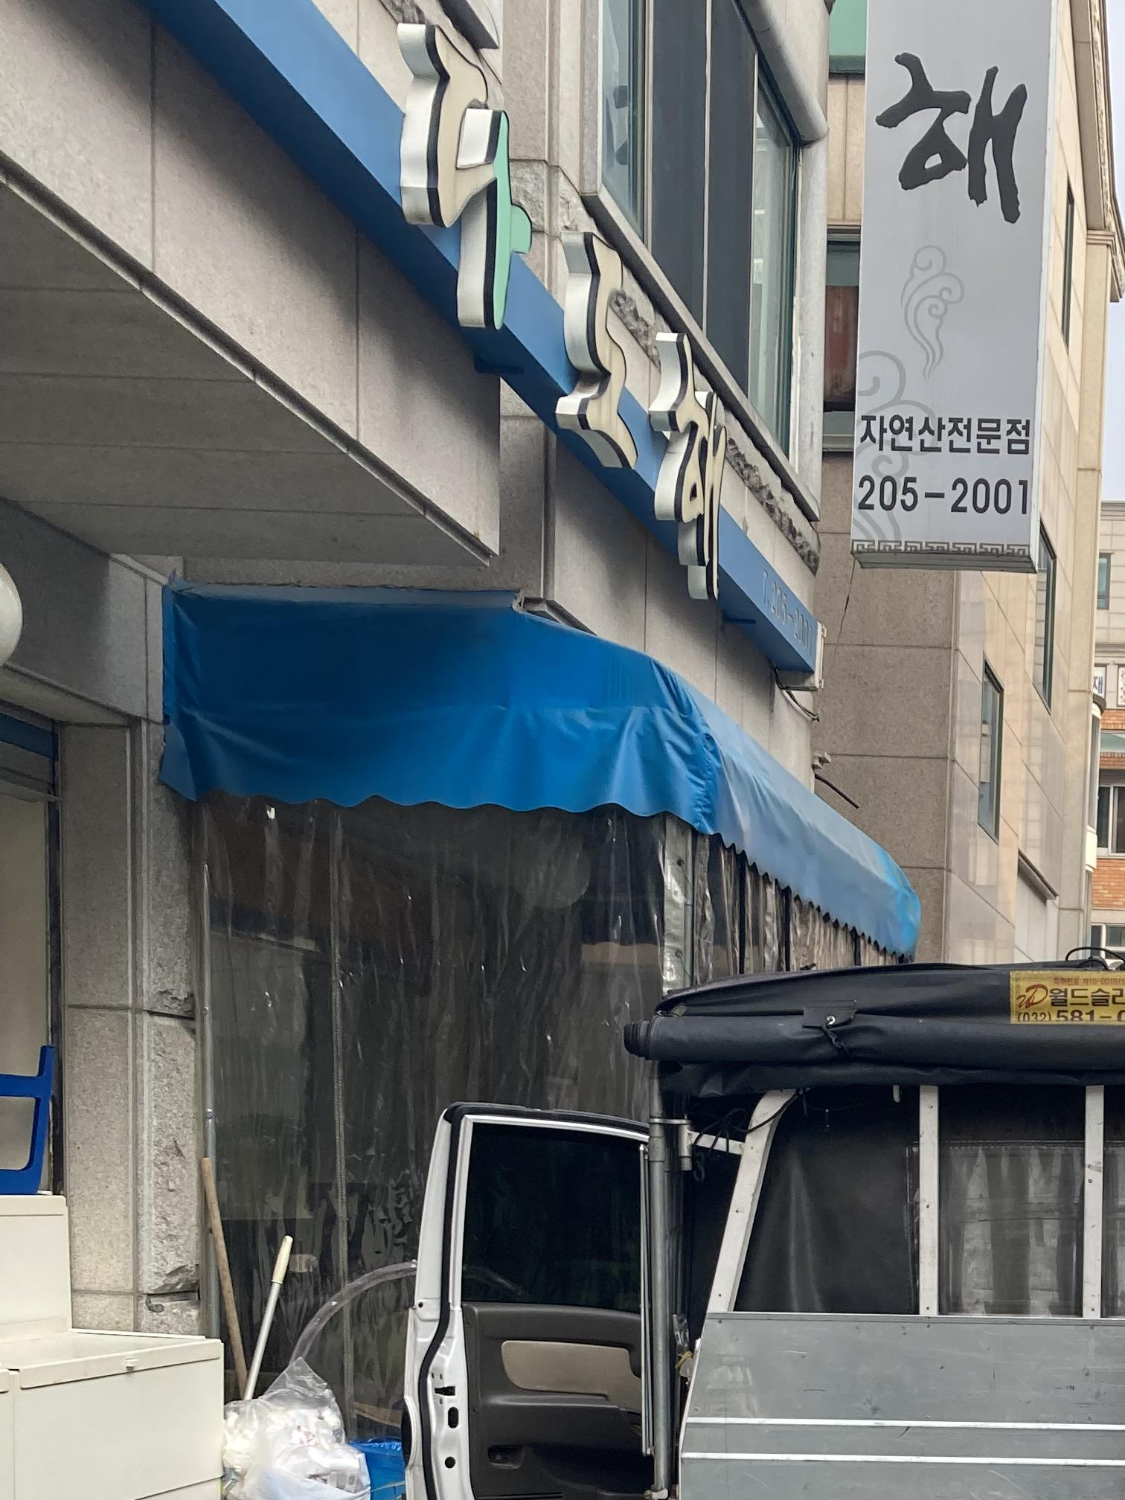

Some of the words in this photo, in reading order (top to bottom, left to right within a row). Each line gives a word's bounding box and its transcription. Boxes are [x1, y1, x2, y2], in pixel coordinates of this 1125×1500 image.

[875, 52, 1028, 224] 해
[860, 414, 1031, 455] 자연산전문점
[858, 474, 1029, 515] 205-2001
